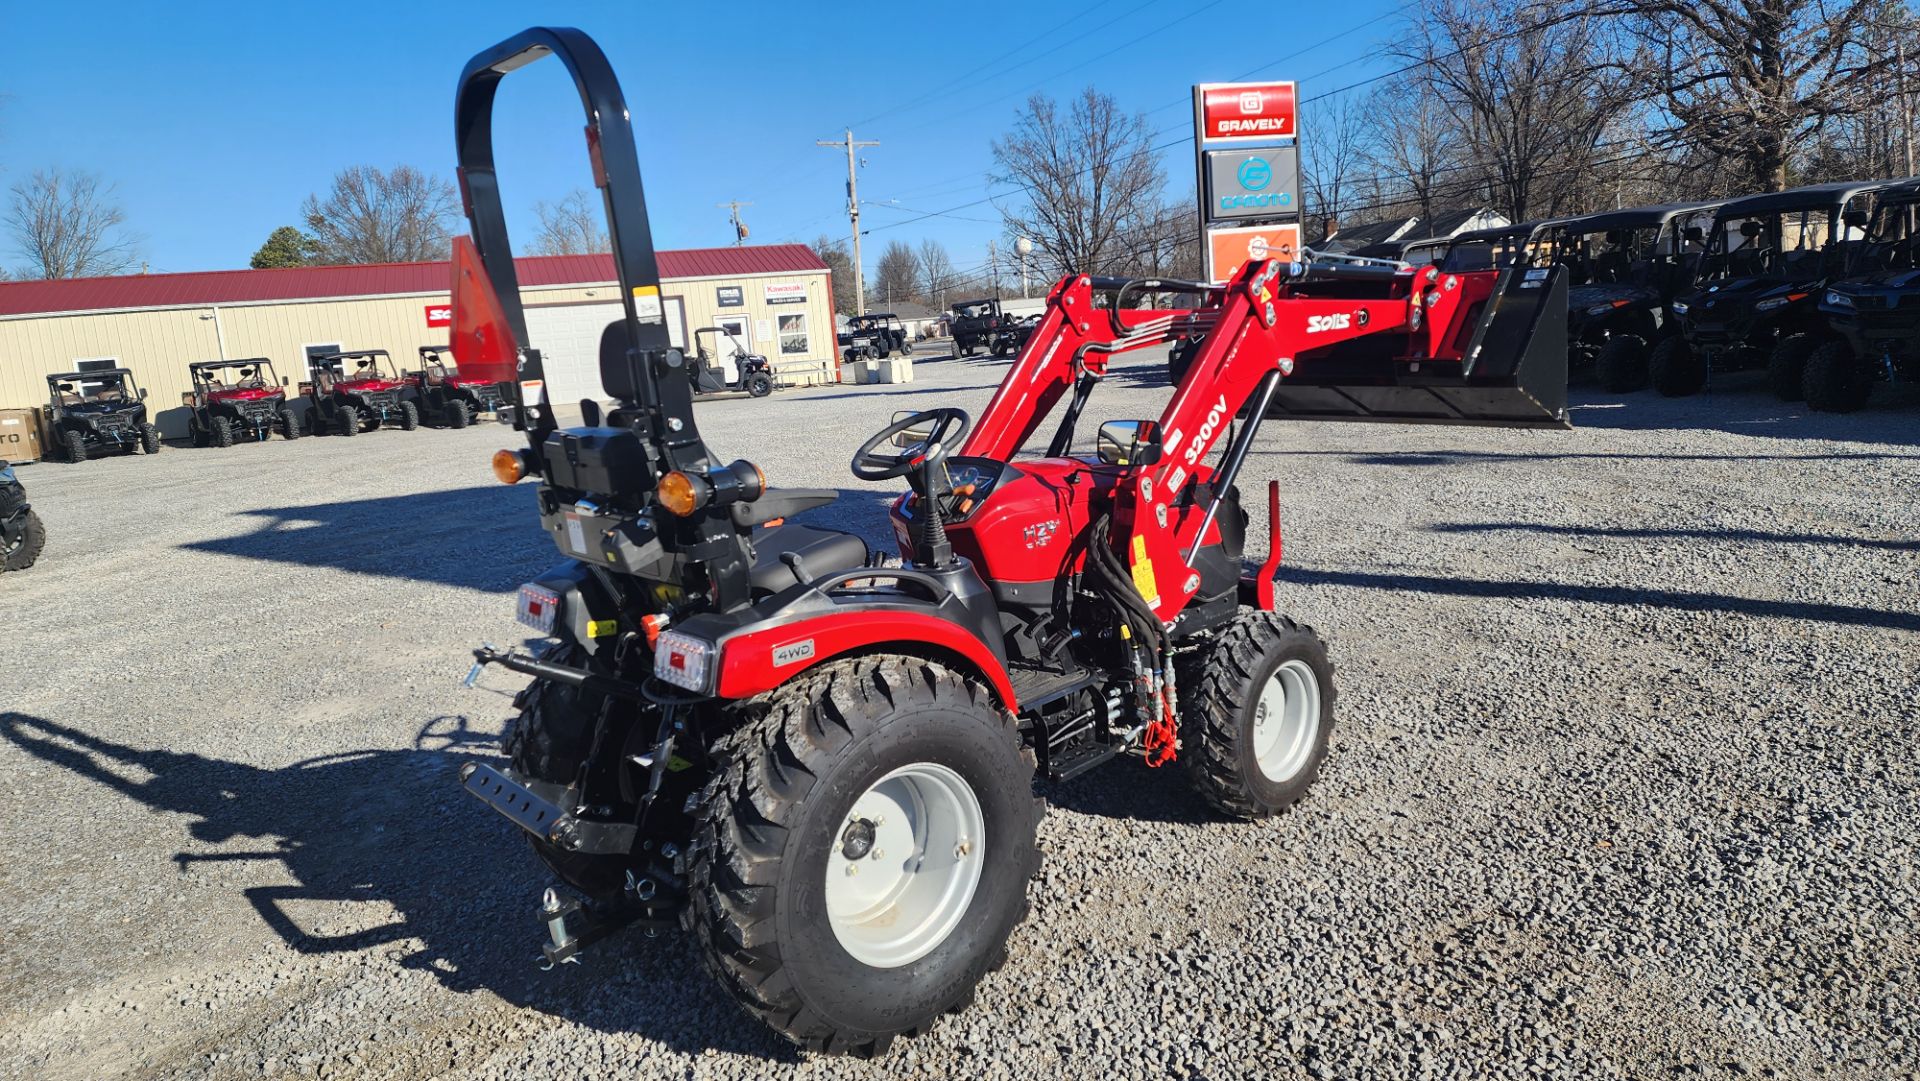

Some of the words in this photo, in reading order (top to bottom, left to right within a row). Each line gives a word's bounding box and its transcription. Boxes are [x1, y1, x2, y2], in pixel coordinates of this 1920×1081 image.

[1218, 118, 1285, 132] GRAVELY
[767, 284, 803, 293] Kawasaki
[1306, 313, 1351, 333] Solis
[1185, 394, 1227, 465] 3200V
[778, 645, 810, 659] 4WD
